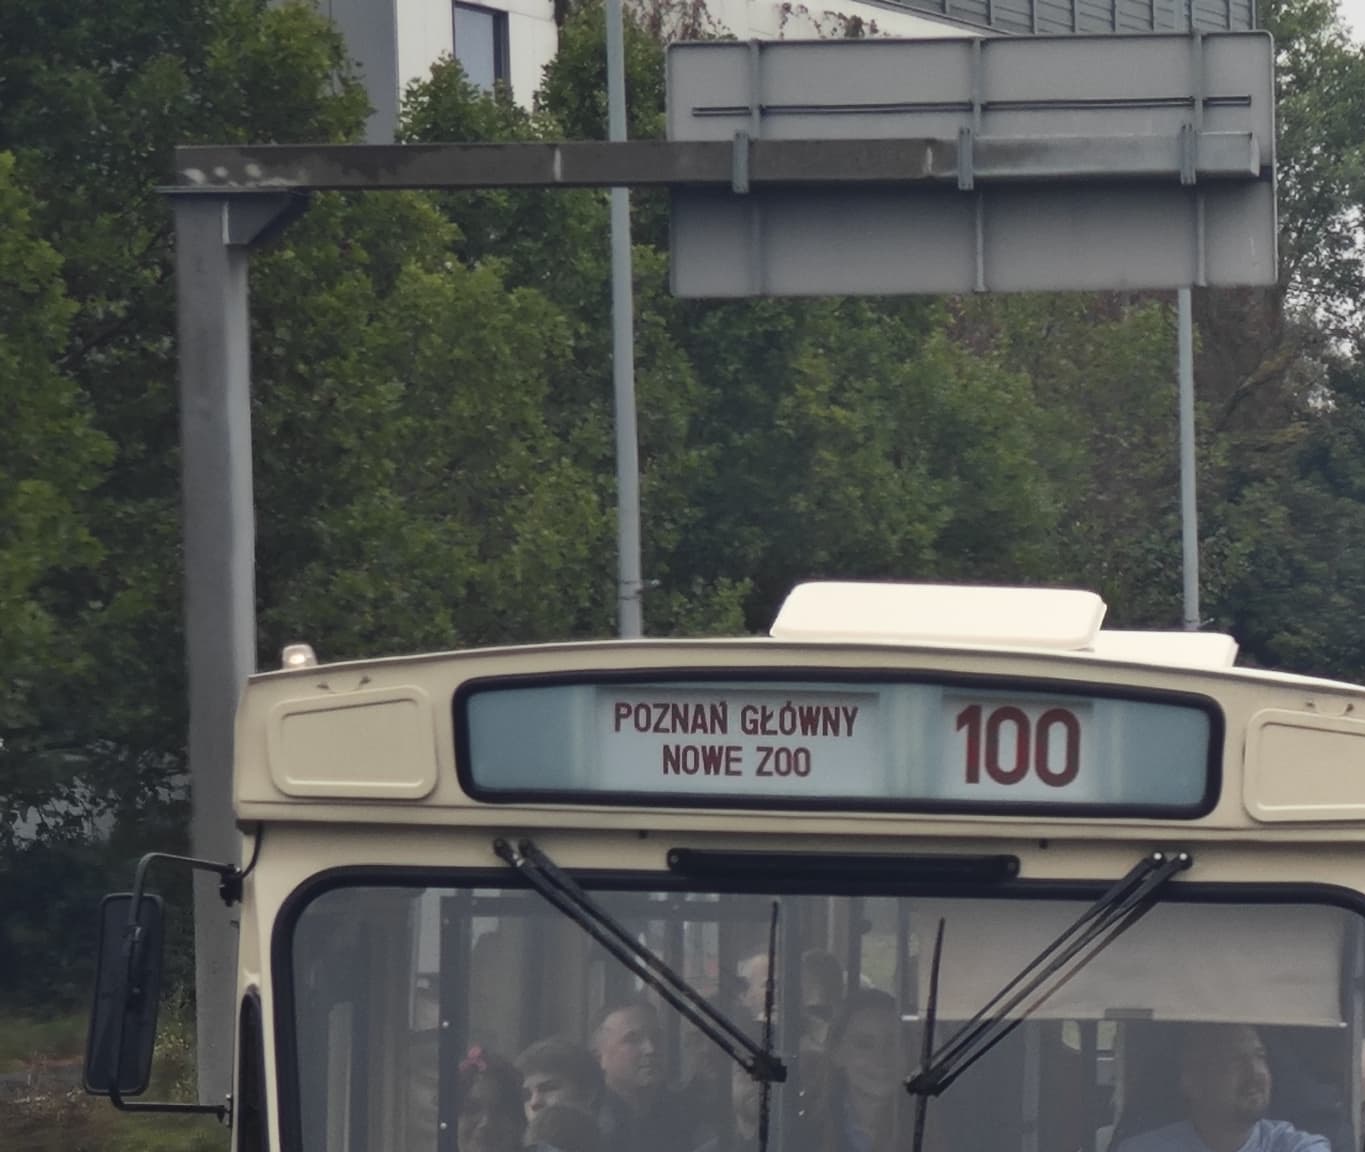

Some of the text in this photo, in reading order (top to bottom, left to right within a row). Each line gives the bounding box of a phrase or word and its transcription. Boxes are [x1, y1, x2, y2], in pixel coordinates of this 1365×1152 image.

[614, 700, 858, 737] POZNAŃ GŁÓWNY
[662, 745, 811, 777] NOWE ZOO
[956, 704, 1081, 788] 100
